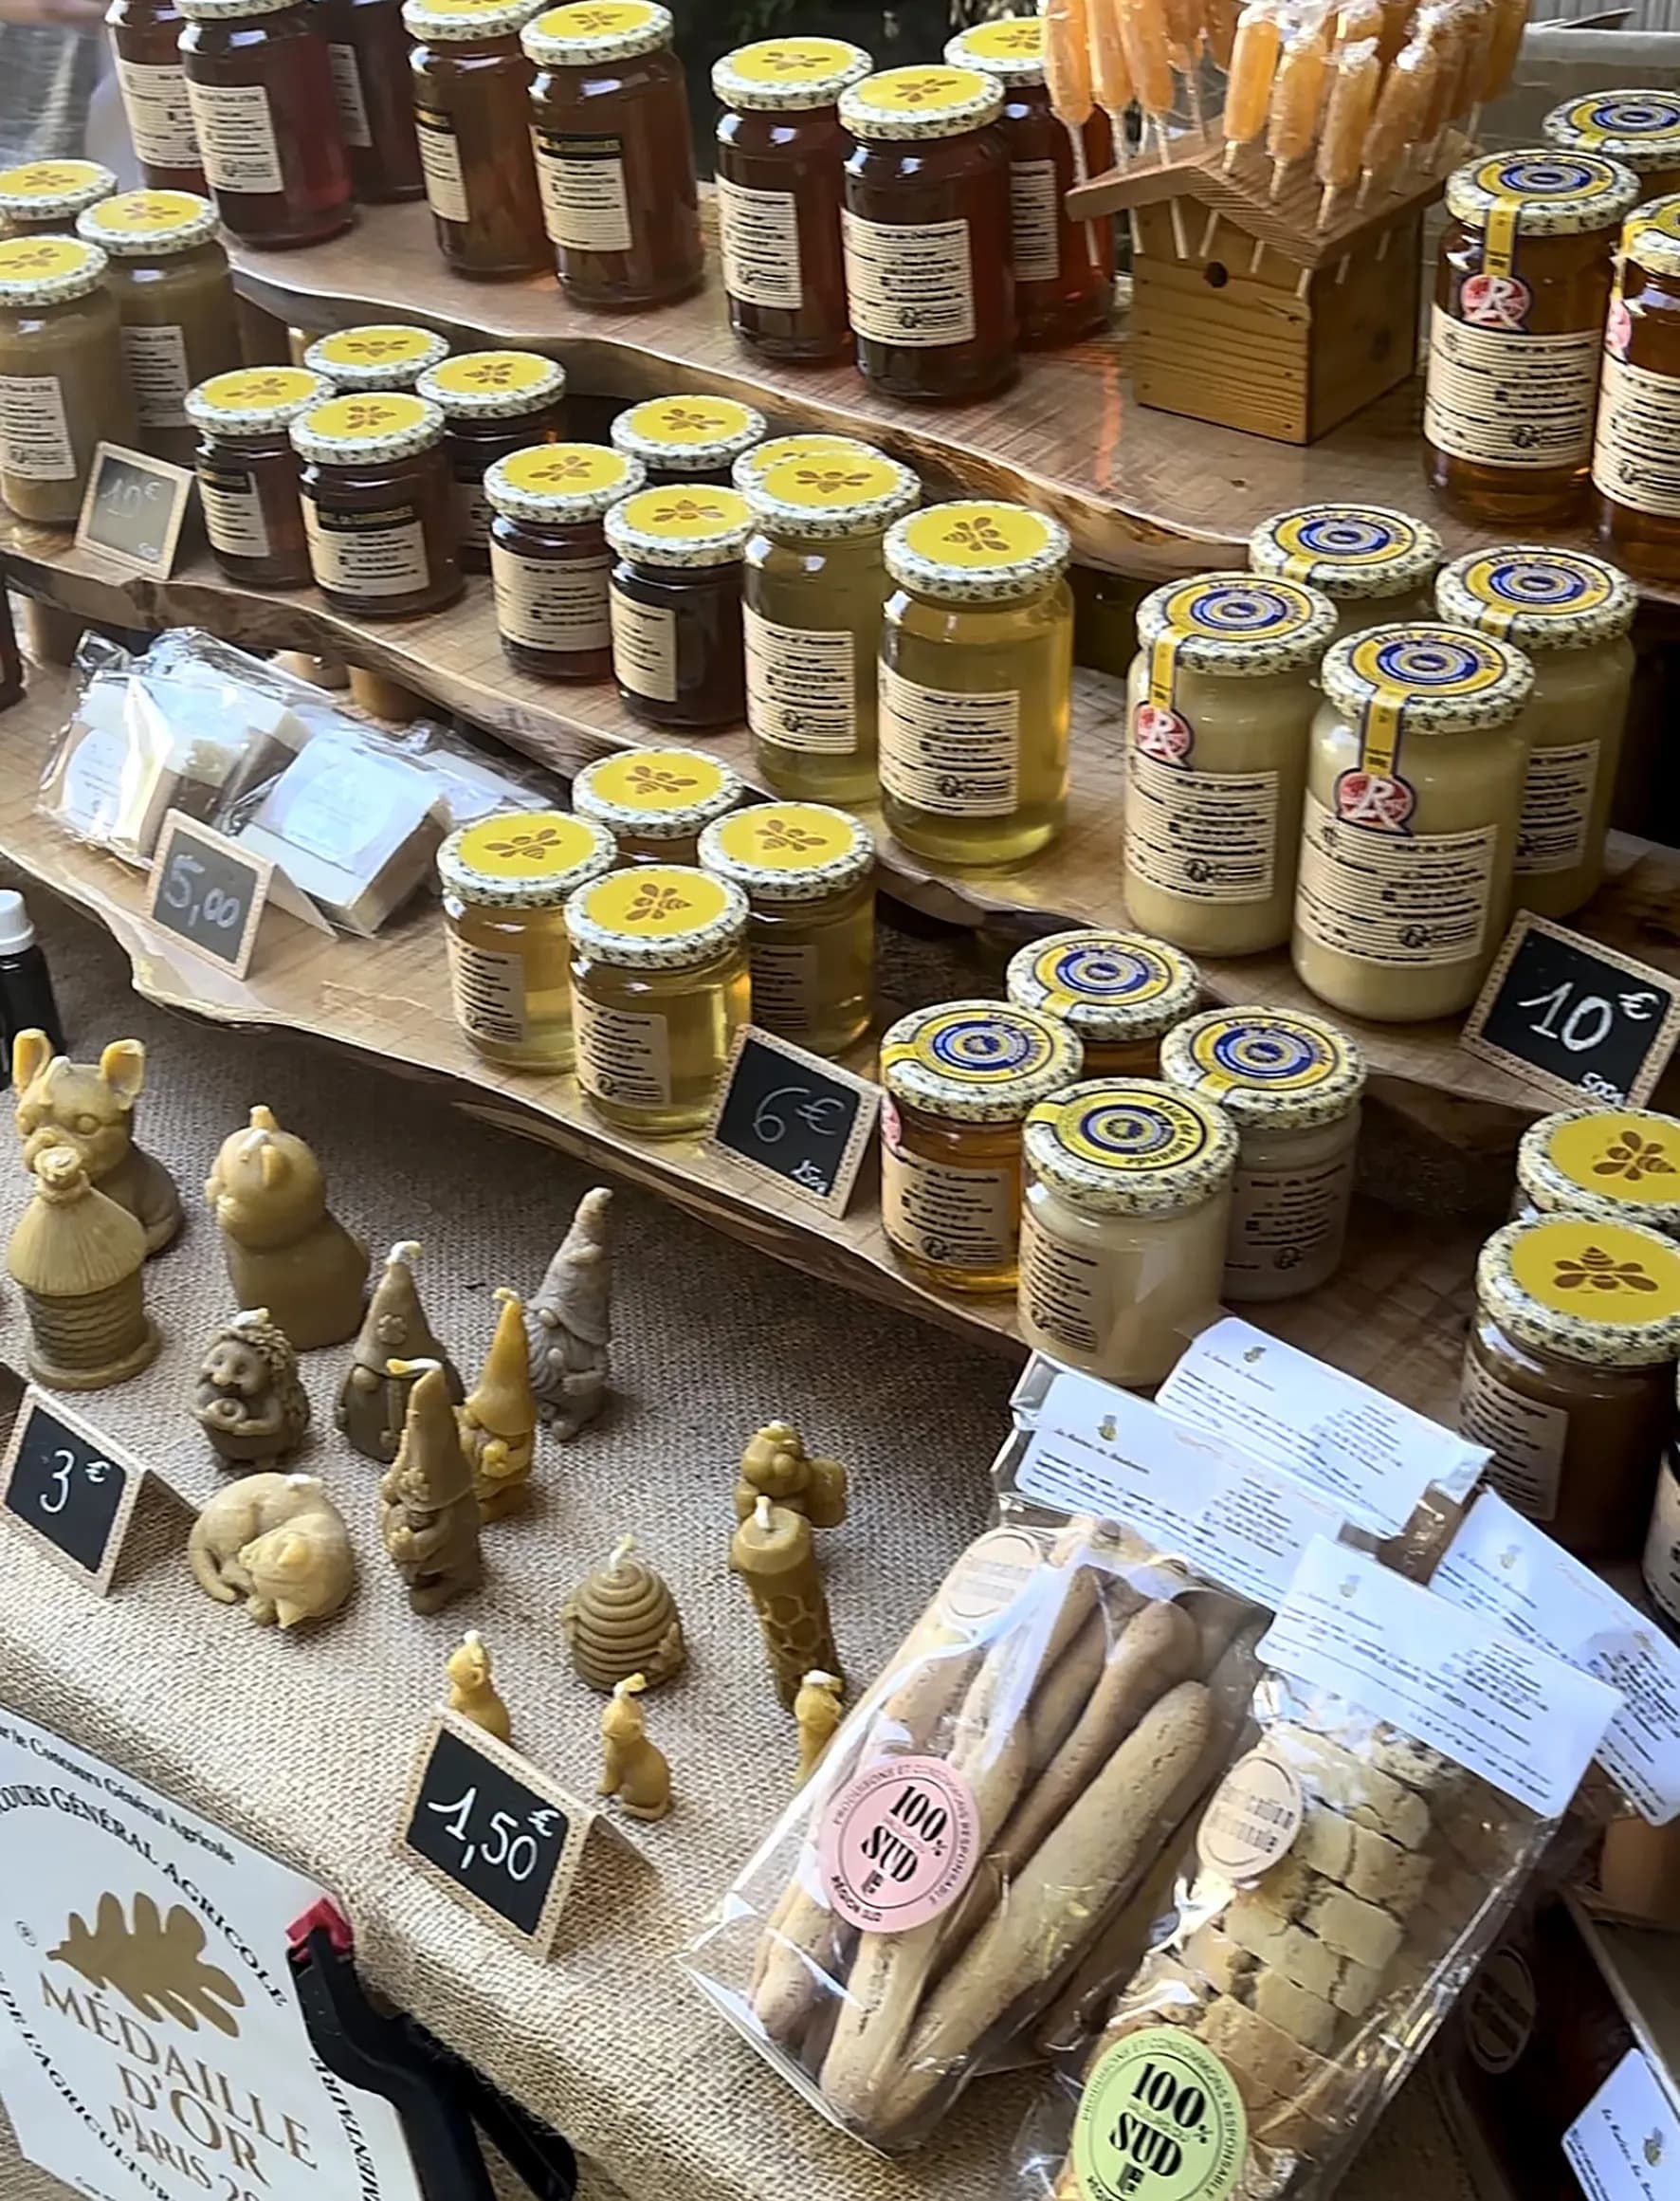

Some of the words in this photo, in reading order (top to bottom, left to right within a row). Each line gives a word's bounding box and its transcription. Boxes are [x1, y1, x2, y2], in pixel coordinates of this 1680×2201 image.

[163, 853, 241, 928] 5,00
[1517, 981, 1661, 1052] 10€
[752, 1086, 847, 1143] 6€
[39, 1449, 112, 1513] 3€
[427, 1787, 561, 1880] 1,50€
[860, 1825, 918, 1883] SUD
[889, 1785, 948, 1857] 100%
[50, 1786, 157, 1865] GÉNÉRAL
[162, 1862, 287, 2007] AGRICOLE
[40, 1972, 318, 2170] MÉDAILLE
[1131, 2062, 1214, 2145] 100%
[109, 2104, 212, 2190] PARIS
[117, 2063, 272, 2189] D'OR
[1109, 2111, 1182, 2177] SUD
